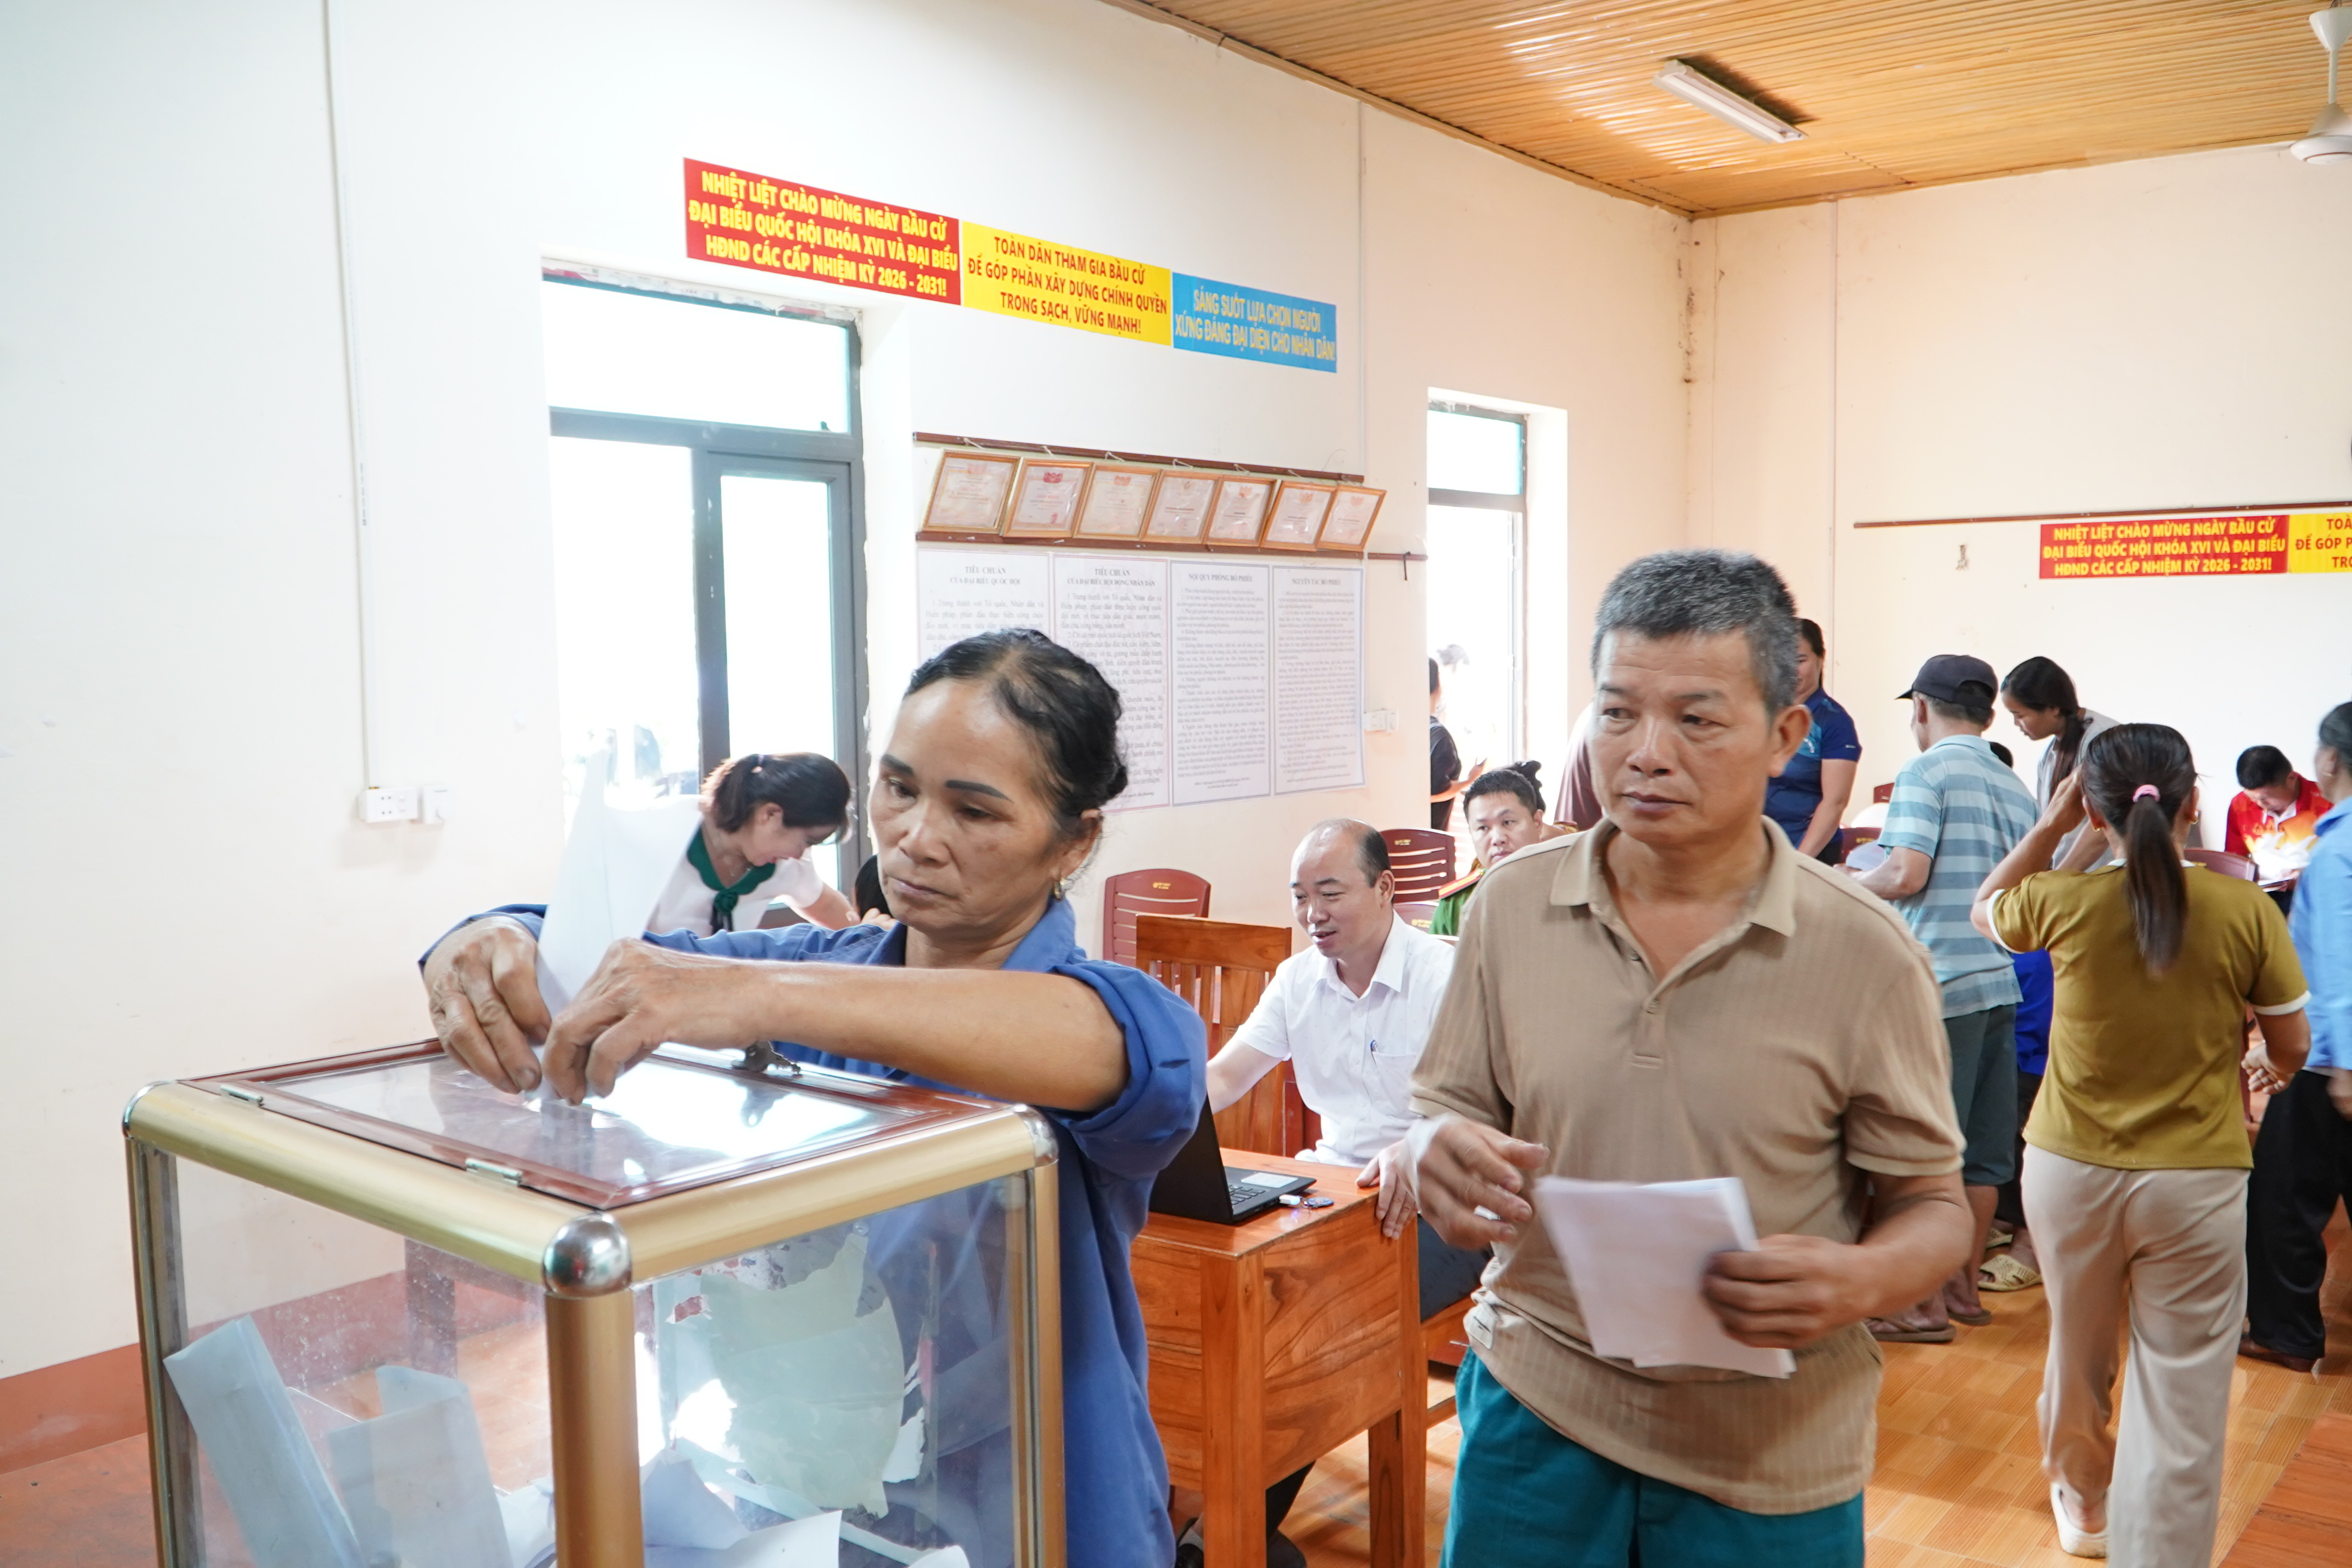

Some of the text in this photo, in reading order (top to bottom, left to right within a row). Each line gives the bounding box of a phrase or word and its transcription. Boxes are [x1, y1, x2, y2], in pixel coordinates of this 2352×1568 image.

[702, 171, 947, 241] NHIỆT LIỆT CHÀO MỪNG NGÀY BẦU CỬ
[688, 200, 957, 271] ĐẠI BIỂU QUỐC HỘI KHÓA XVI VÀ ĐẠI BIỂU
[706, 234, 749, 261] HĐND
[753, 240, 781, 268] CÁC
[783, 245, 810, 271] CẤP
[813, 253, 856, 283] NHIỆM
[859, 259, 875, 284] KỲ
[878, 267, 906, 289] 2026
[917, 274, 947, 296] 2031!
[994, 236, 1145, 284] TOÀN DÂN THAM GIA BẦU CỬ
[968, 253, 1167, 314] ĐỂ GÓP PHẦN XÂY DỰNG CHÍNH QUYỀN
[1000, 292, 1141, 334] TRONG SẠCH, VỮNG MẠNH!
[2043, 534, 2285, 561] ĐẠI BIỂU QUỐC HỘI KHÓA XVI VÀ ĐẠI BIỂU
[2054, 517, 2276, 542] NHIỆT LIỆT CHÀO MỪNG NGÀY BẦU CỬ
[2295, 533, 2312, 550] ĐỂ
[2316, 534, 2342, 550] GÓP
[2055, 563, 2088, 575] HĐND
[2091, 559, 2114, 575] CÁC
[2117, 558, 2140, 574] CẤP
[2142, 557, 2182, 576] NHIỆM
[2185, 556, 2200, 572] KỲ
[2203, 558, 2230, 572] 2026
[2241, 558, 2272, 571] 2031!
